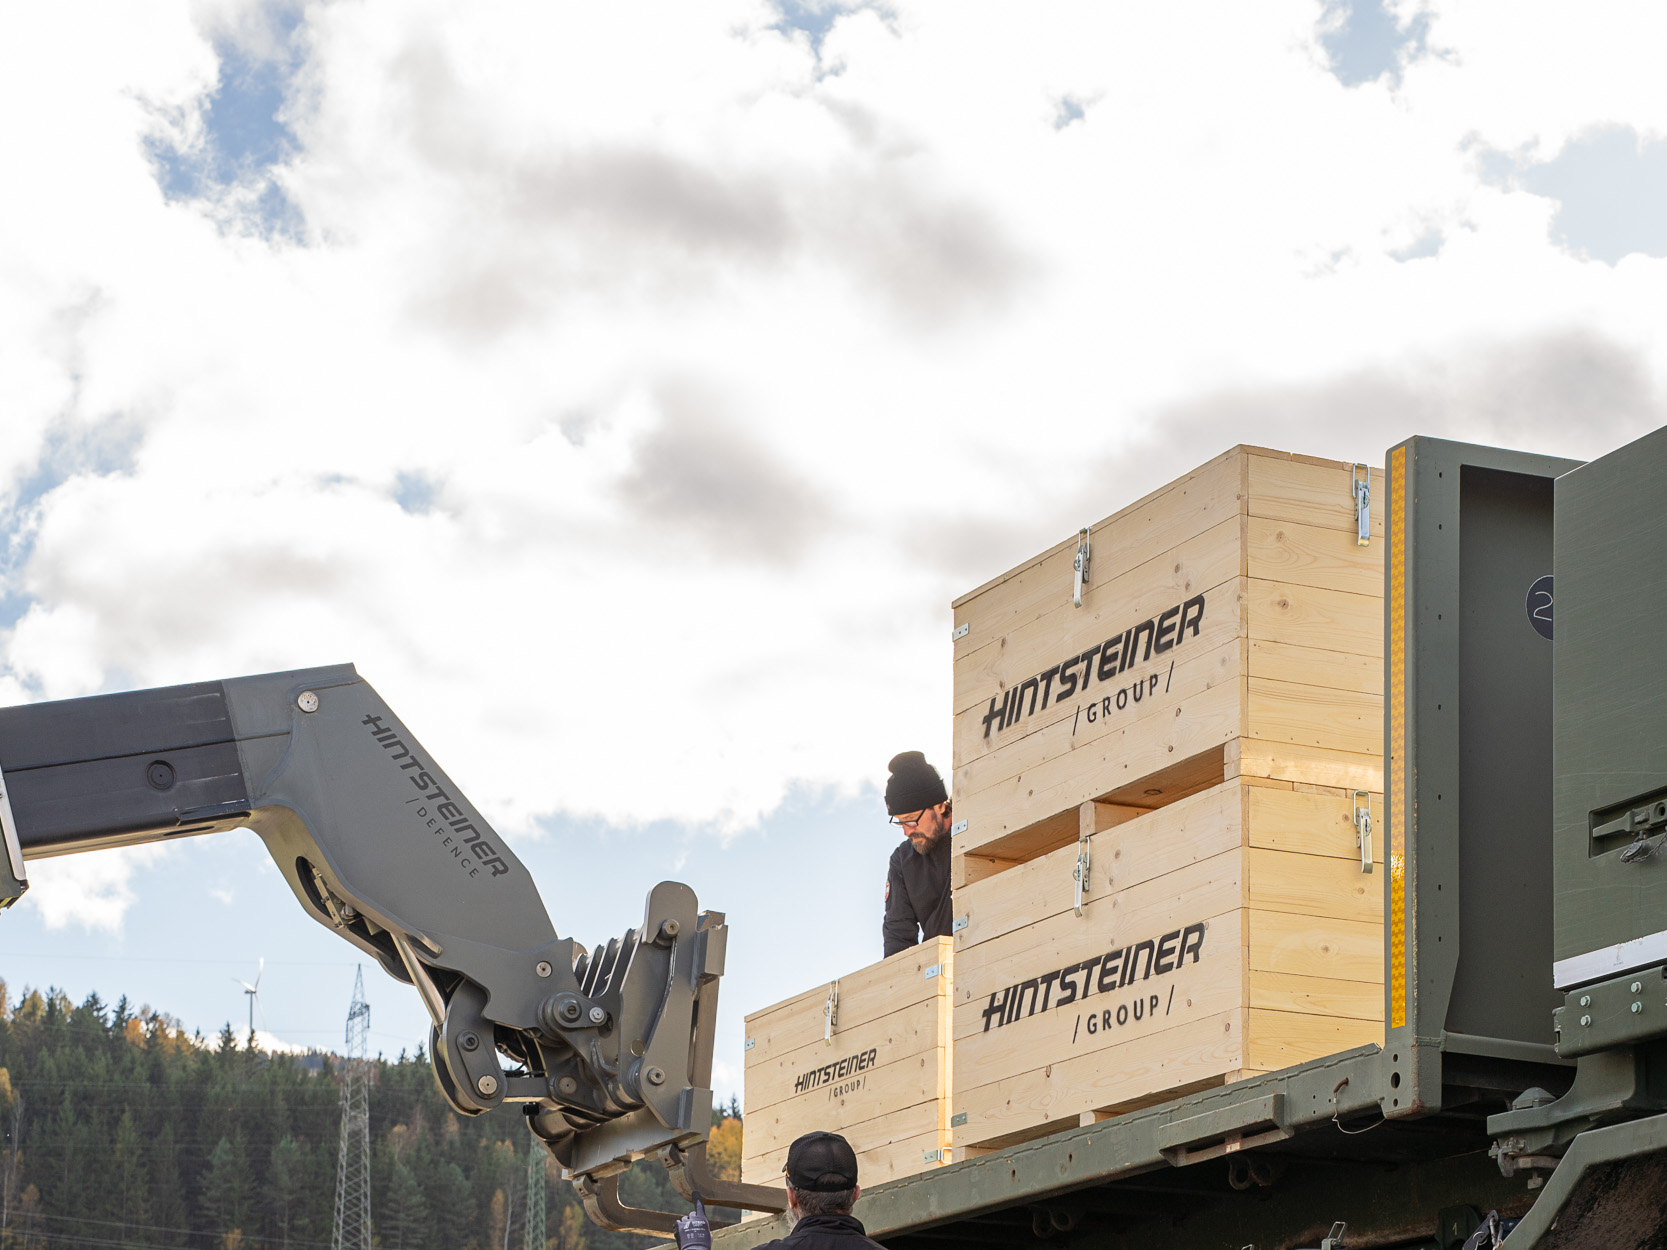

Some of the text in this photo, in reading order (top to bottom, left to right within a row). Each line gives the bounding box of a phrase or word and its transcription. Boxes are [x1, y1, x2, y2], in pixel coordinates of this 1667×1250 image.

[1533, 591, 1553, 621] 2
[982, 594, 1205, 739] HINTSTEINER
[361, 714, 509, 878] HINTSTEINER
[982, 922, 1205, 1033] HINTSTEINER
[794, 1048, 877, 1094] HINTSTEINER
